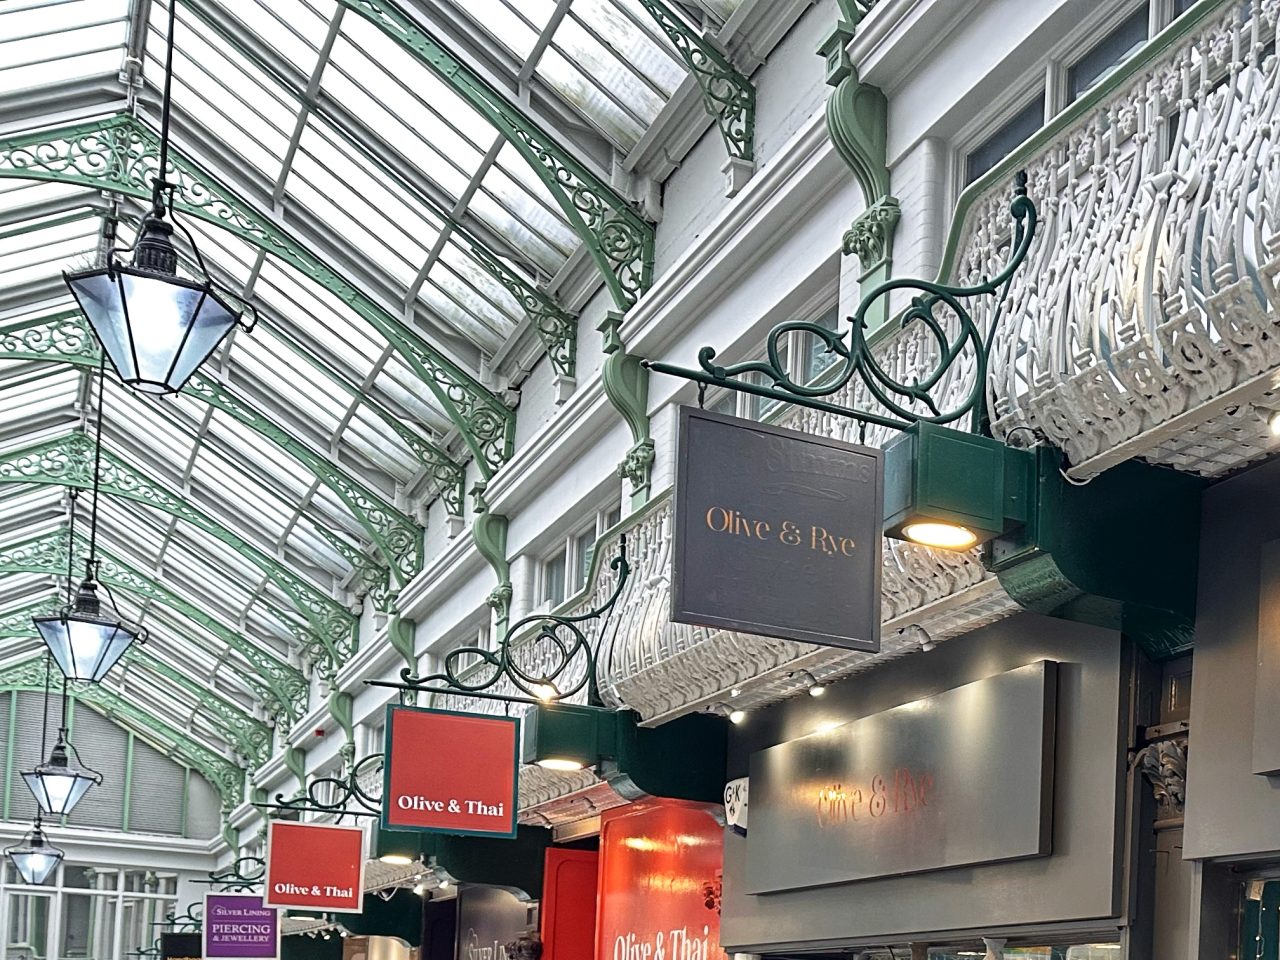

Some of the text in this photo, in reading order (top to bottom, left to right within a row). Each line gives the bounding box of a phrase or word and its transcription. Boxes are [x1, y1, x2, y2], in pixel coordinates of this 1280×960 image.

[706, 506, 856, 557] Olive & Rye
[869, 773, 887, 818] &
[397, 794, 505, 818] Olive & Thai
[274, 883, 353, 898] Olive & Thai
[243, 908, 271, 917] LINING
[212, 924, 271, 934] PIERCING
